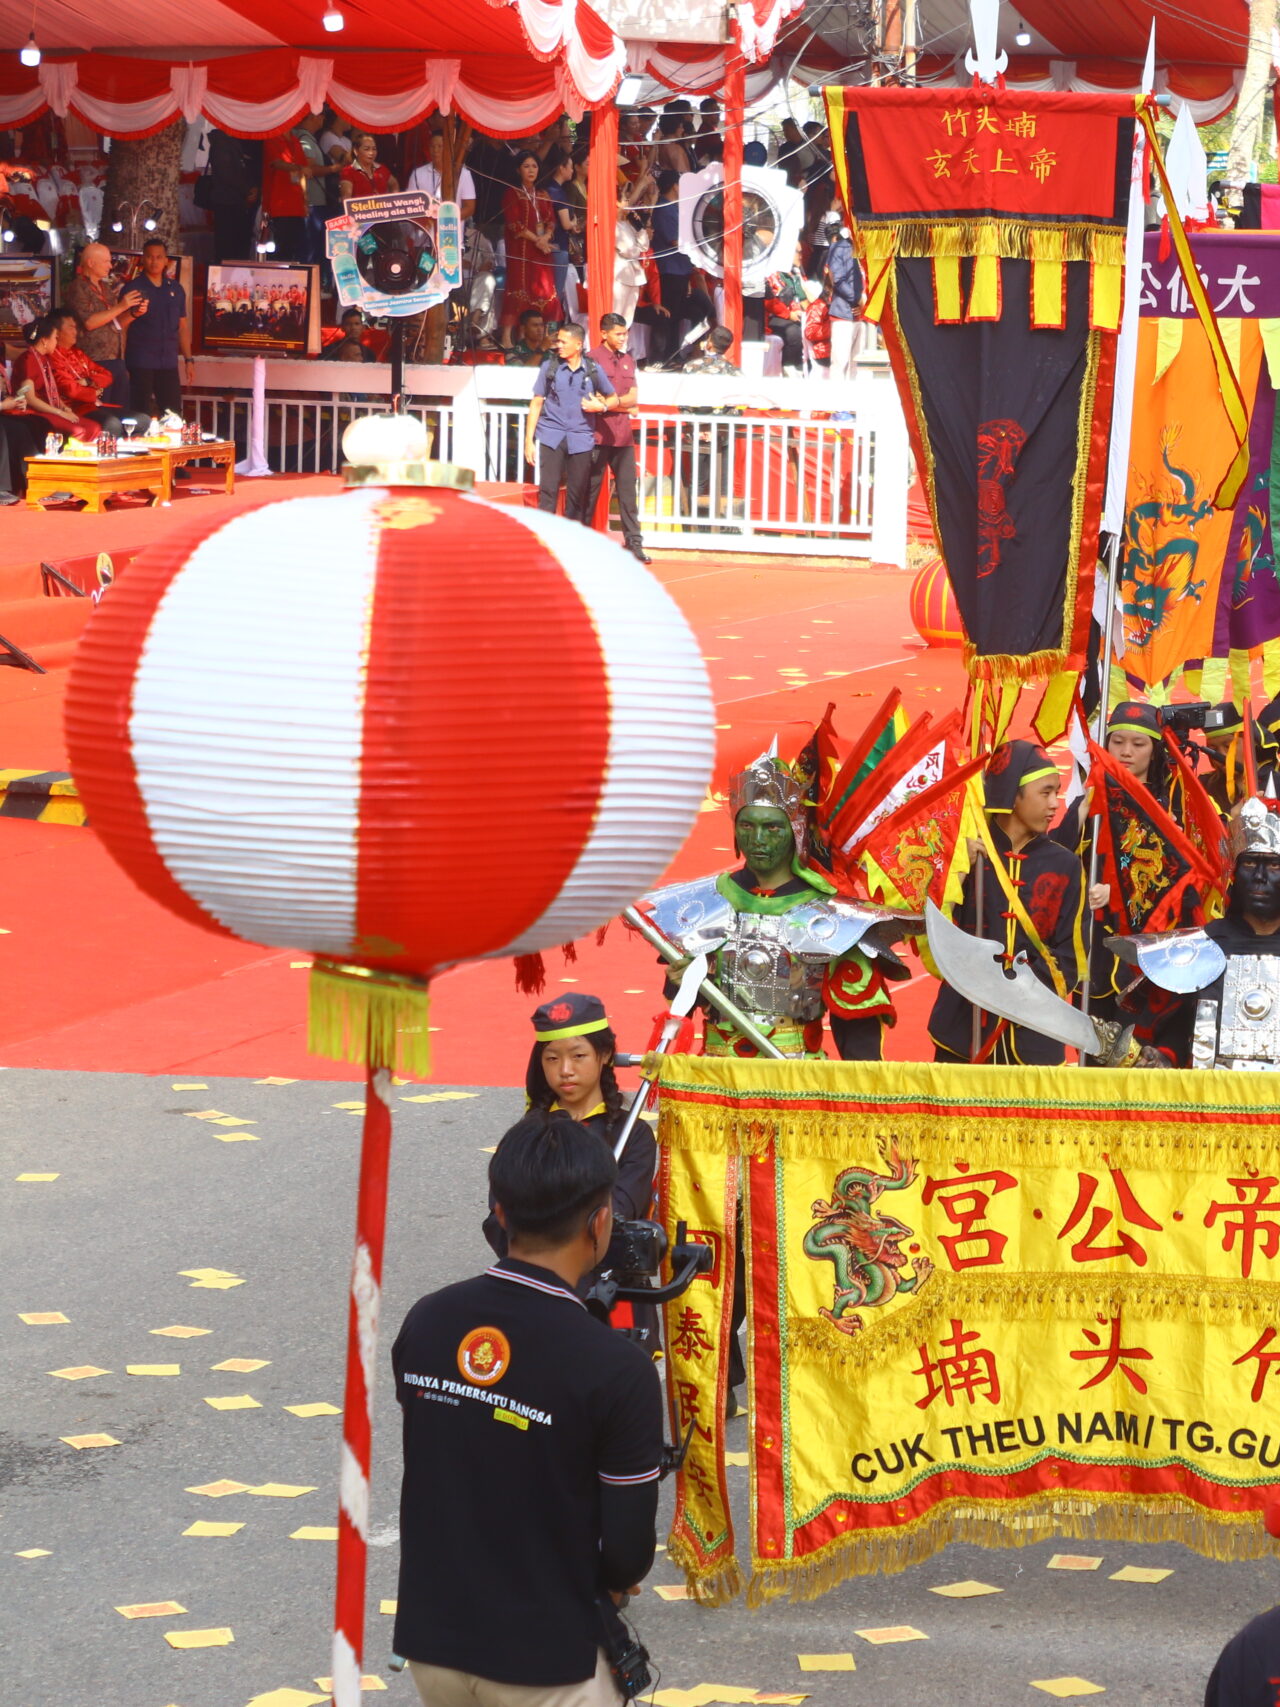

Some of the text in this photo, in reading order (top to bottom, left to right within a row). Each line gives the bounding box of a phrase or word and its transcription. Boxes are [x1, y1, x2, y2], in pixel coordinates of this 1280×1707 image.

[354, 210, 389, 220] Healing
[403, 1373, 439, 1390] BUDAYA
[441, 1379, 508, 1408] PEMERSATU
[509, 1400, 553, 1425] BANGSA
[851, 1433, 935, 1483] CUK
[941, 1415, 1046, 1459] THEU
